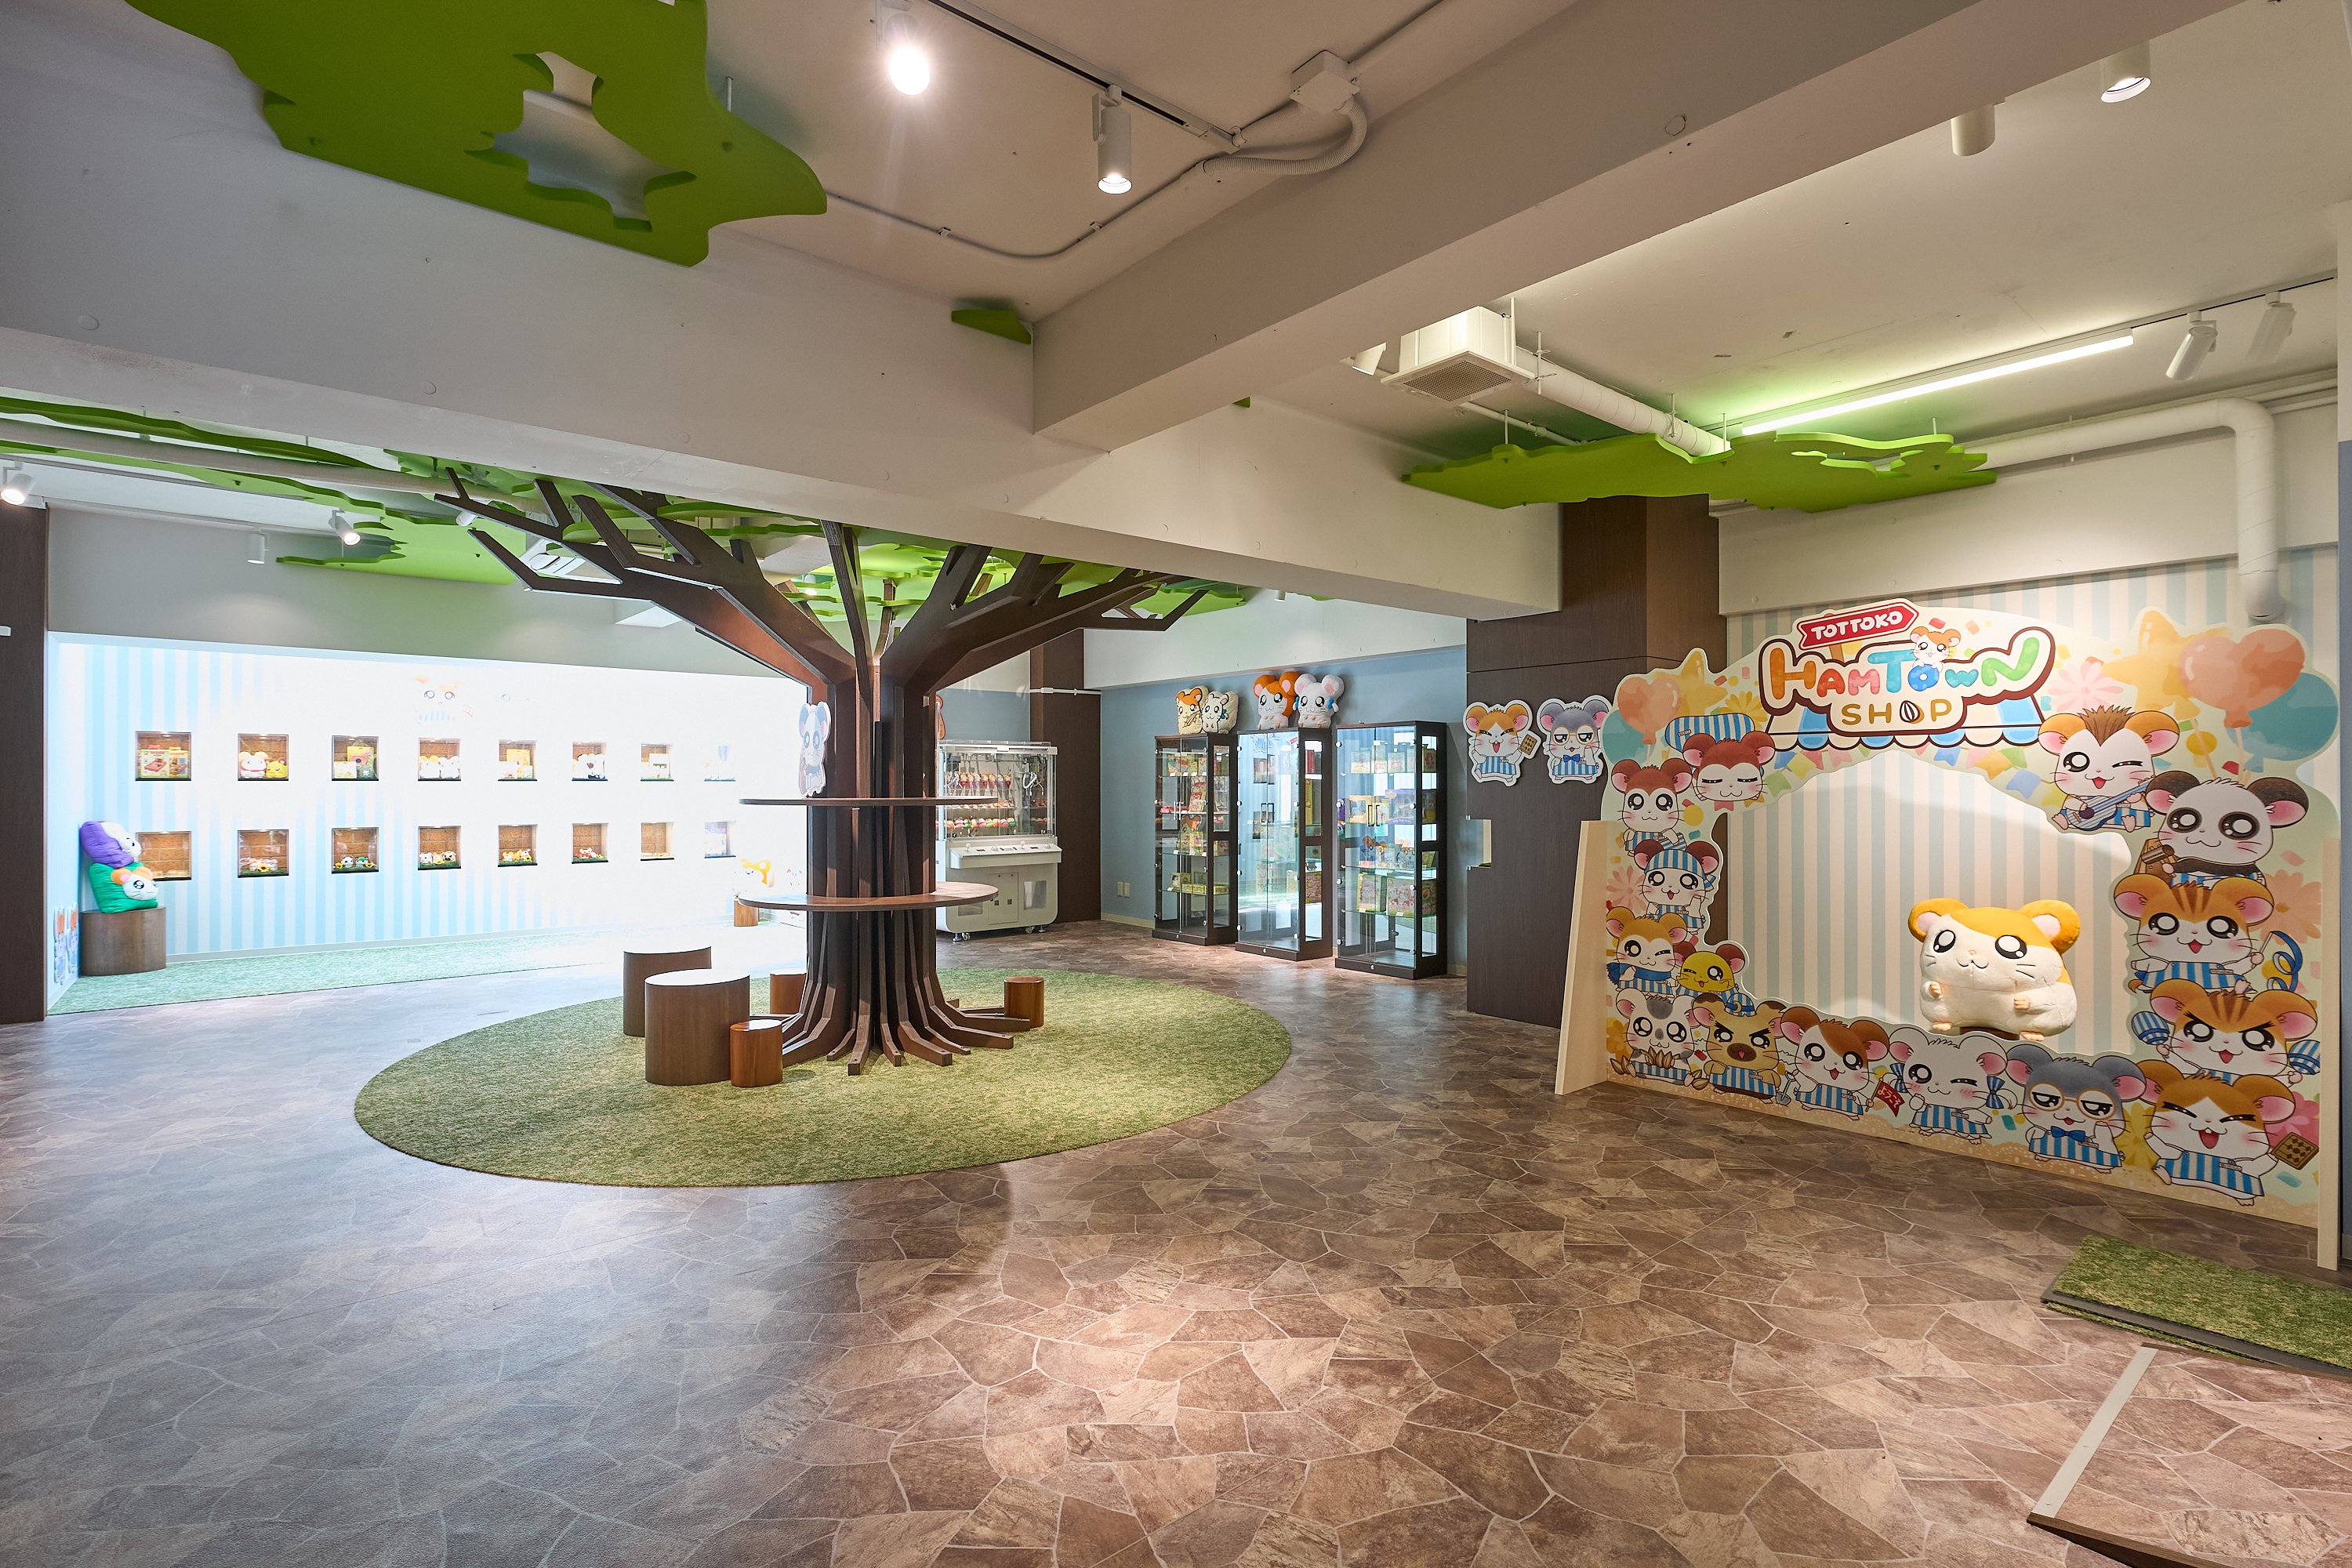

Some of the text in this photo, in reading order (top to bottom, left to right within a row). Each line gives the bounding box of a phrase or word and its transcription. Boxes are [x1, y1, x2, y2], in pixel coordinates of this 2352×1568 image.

[1811, 610, 1904, 641] TOTTOKO
[1842, 699, 1952, 725] SHOP
[1878, 1085, 1901, 1109] ようこそ
